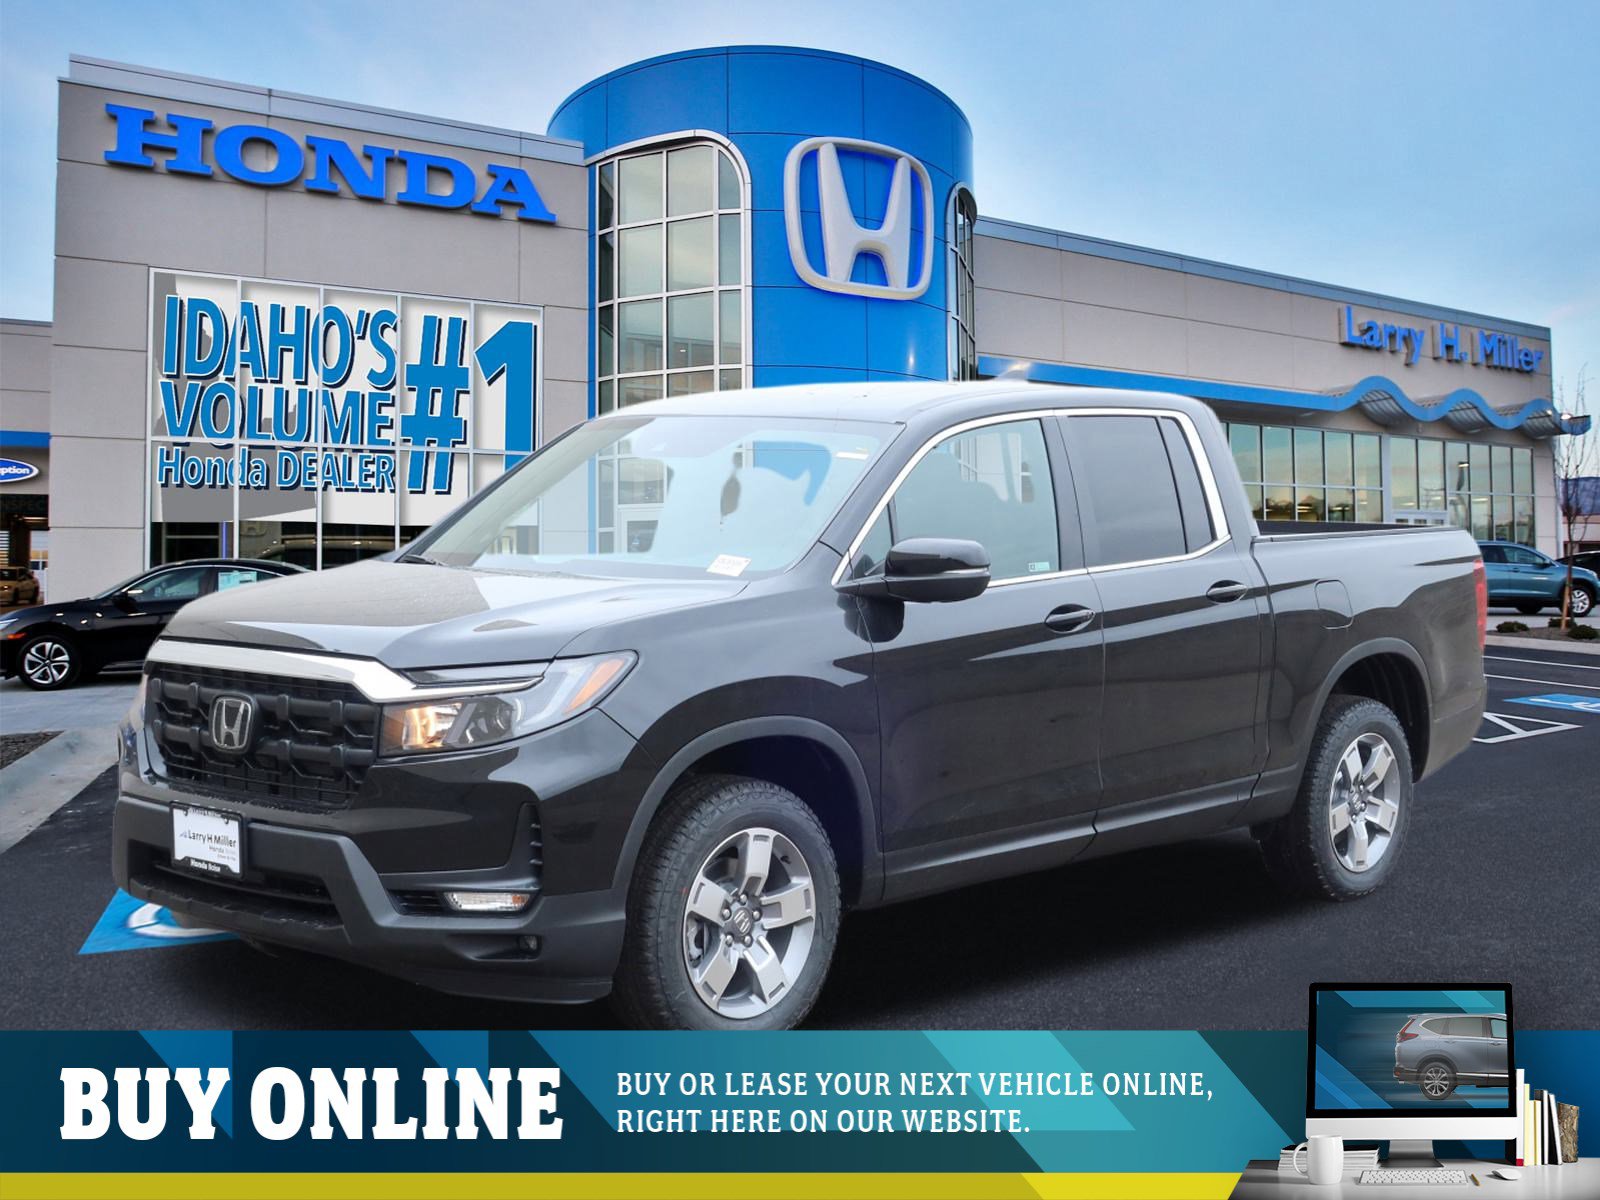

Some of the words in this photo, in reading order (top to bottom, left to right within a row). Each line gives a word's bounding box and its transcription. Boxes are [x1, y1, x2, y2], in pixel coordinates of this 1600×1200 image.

[104, 103, 557, 224] HONDA
[162, 295, 398, 389] IDAHO'S
[1345, 304, 1424, 366] Larry
[1439, 322, 1468, 361] H.
[1479, 330, 1544, 371] Miller
[159, 380, 396, 447] VOLUME
[400, 313, 538, 494] #1
[0, 465, 30, 476] ption
[157, 447, 268, 488] Honda
[276, 450, 396, 492] DEALER
[188, 829, 206, 844] Larry
[207, 834, 213, 844] H
[214, 835, 237, 848] Miller
